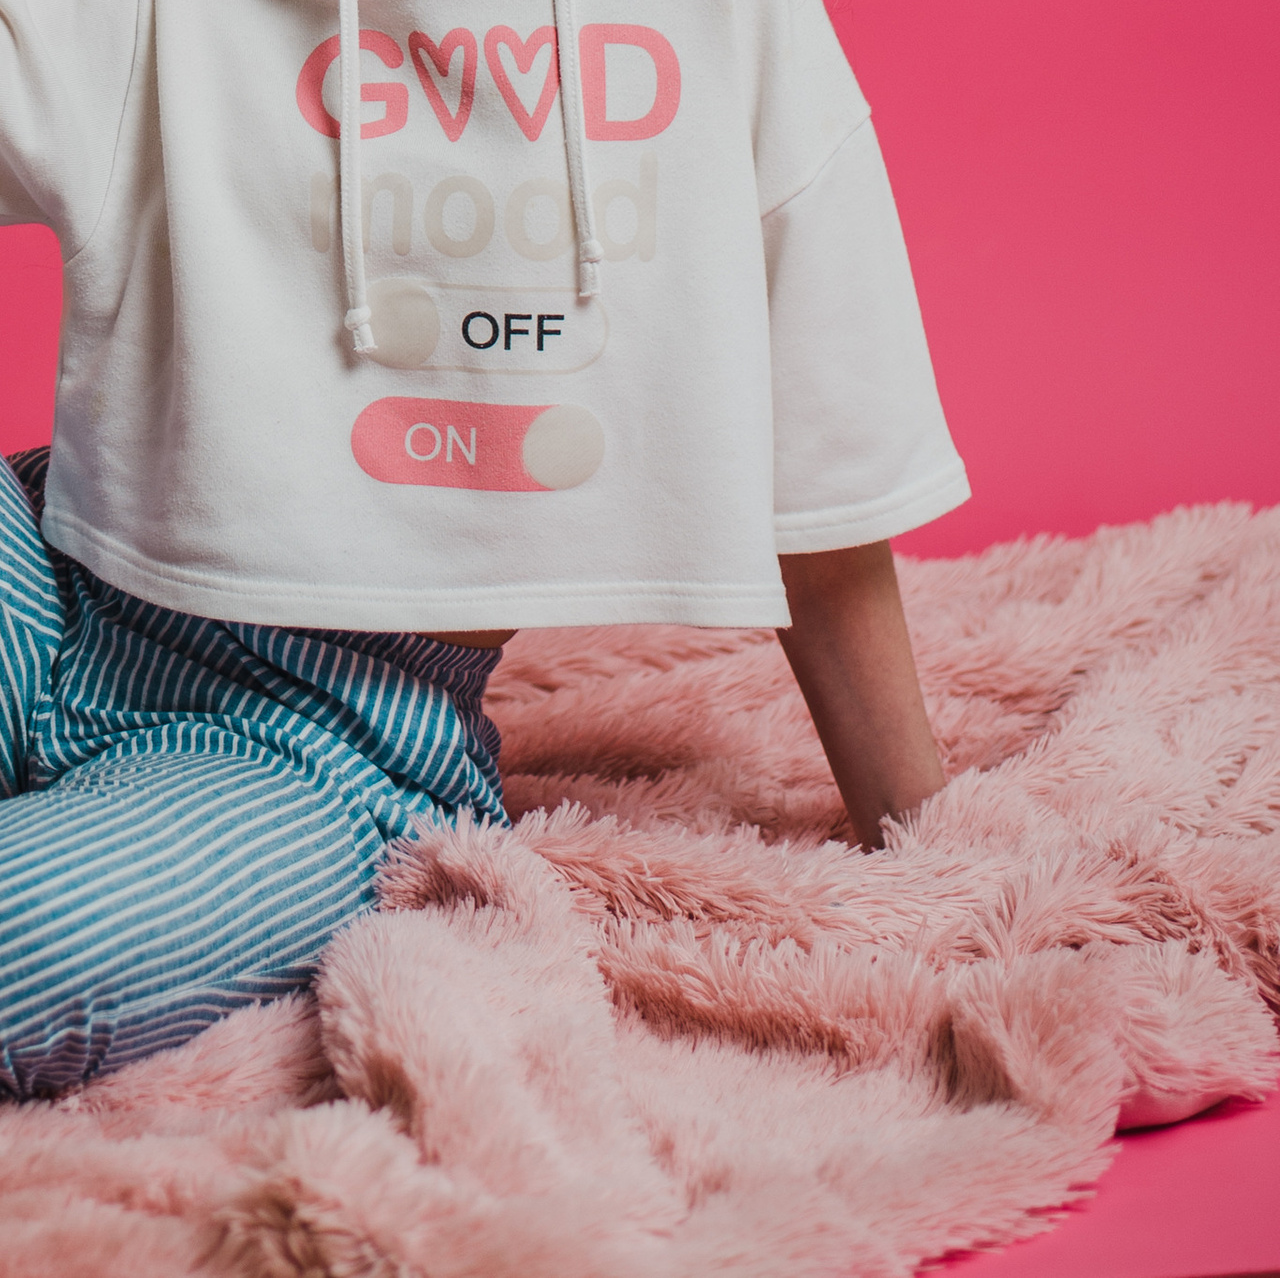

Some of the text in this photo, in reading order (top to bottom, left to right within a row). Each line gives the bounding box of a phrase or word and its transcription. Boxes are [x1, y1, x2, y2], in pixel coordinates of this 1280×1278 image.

[310, 151, 659, 263] mood
[461, 311, 565, 351] OFF
[405, 422, 477, 466] ON
